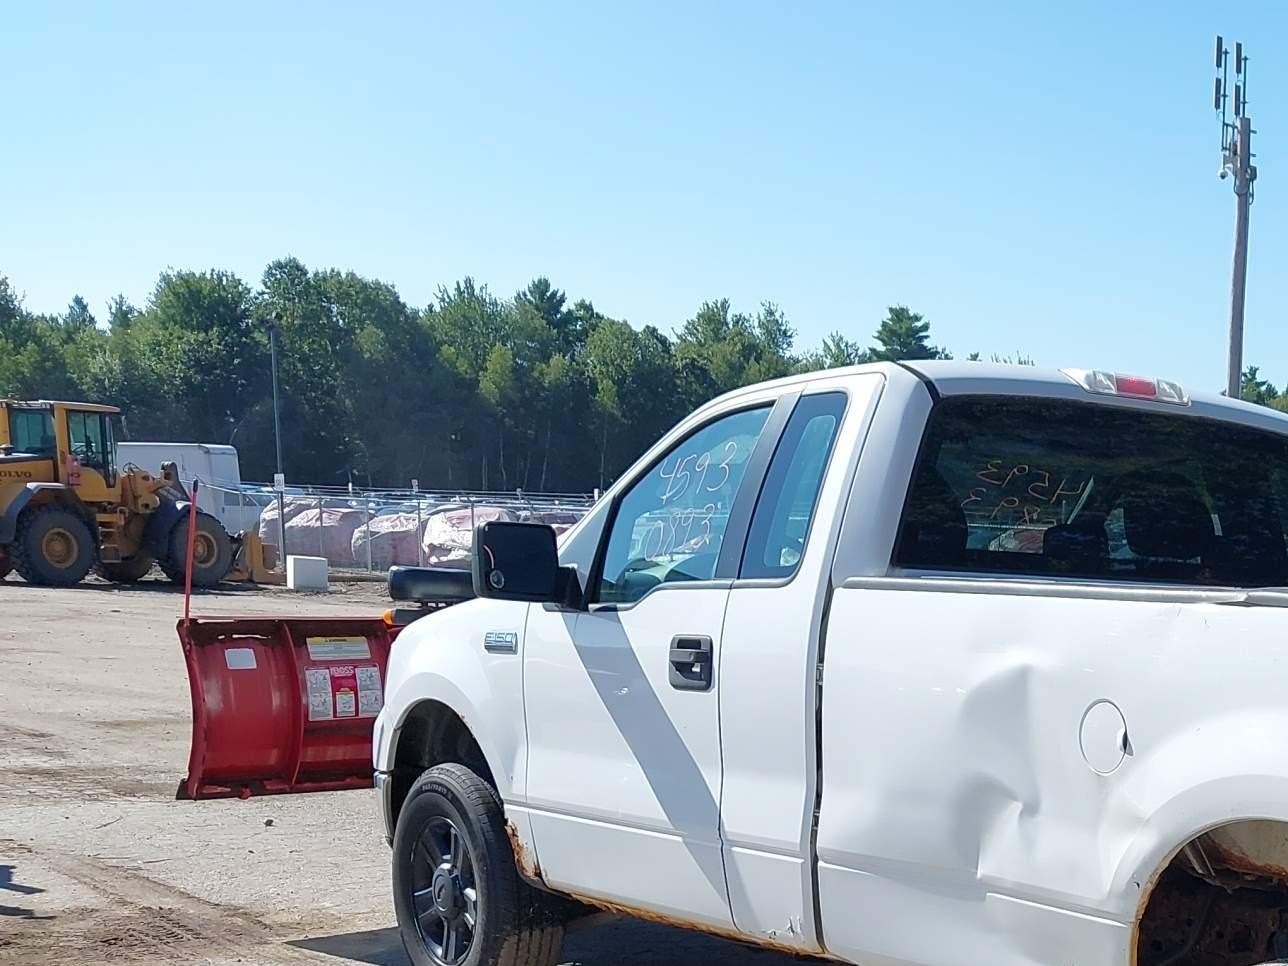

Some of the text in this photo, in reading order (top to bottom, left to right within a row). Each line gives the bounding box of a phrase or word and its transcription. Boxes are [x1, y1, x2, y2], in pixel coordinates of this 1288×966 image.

[0, 470, 32, 479] OLVO
[660, 441, 737, 504] 4593
[645, 503, 716, 561] 0893
